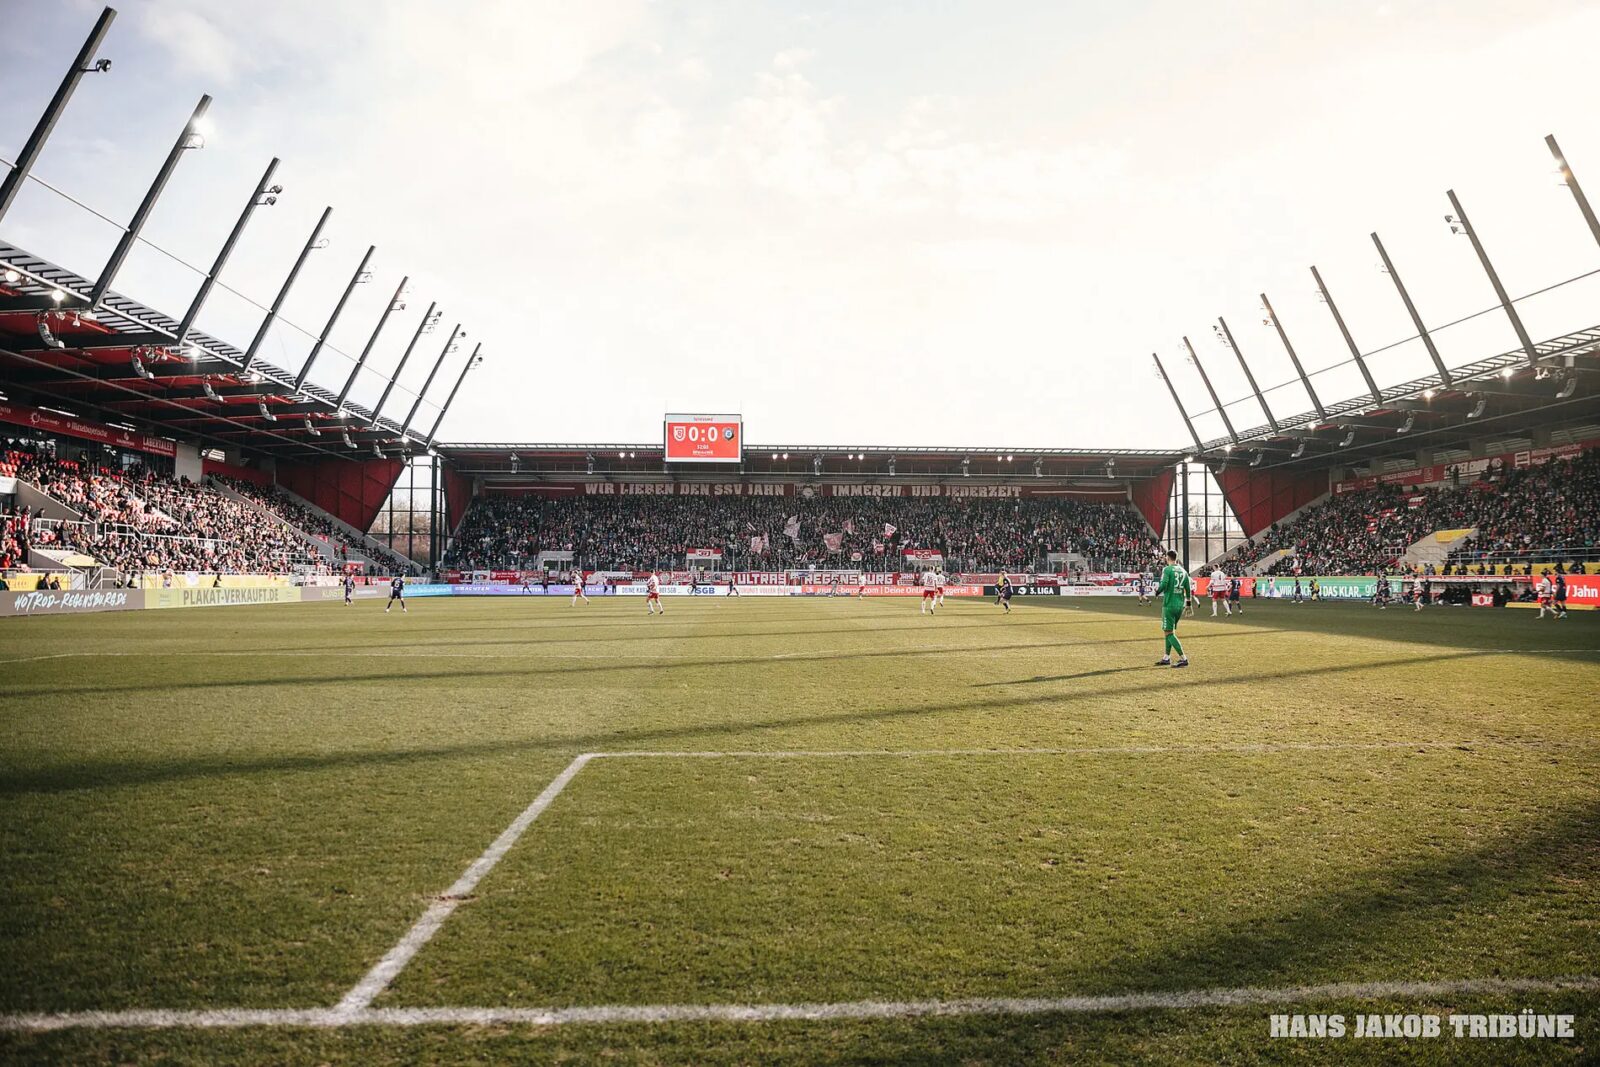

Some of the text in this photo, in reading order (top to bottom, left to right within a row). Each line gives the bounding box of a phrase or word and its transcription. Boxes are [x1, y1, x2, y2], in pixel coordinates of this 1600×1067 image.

[688, 426, 718, 442] 0:0
[585, 483, 785, 496] WIR LIEBEN DEN SSV JAHN
[832, 485, 1022, 497] IMMERZU UND JEDERZEIT
[737, 573, 786, 585] ULTRAS
[804, 574, 894, 585] REGENSURG
[1174, 571, 1185, 588] 32
[183, 588, 279, 605] PLAKAT-VERKAUFT.DE
[1279, 585, 1361, 597] WIR ACHN DAS KLAR.
[1572, 585, 1598, 598] Jahn
